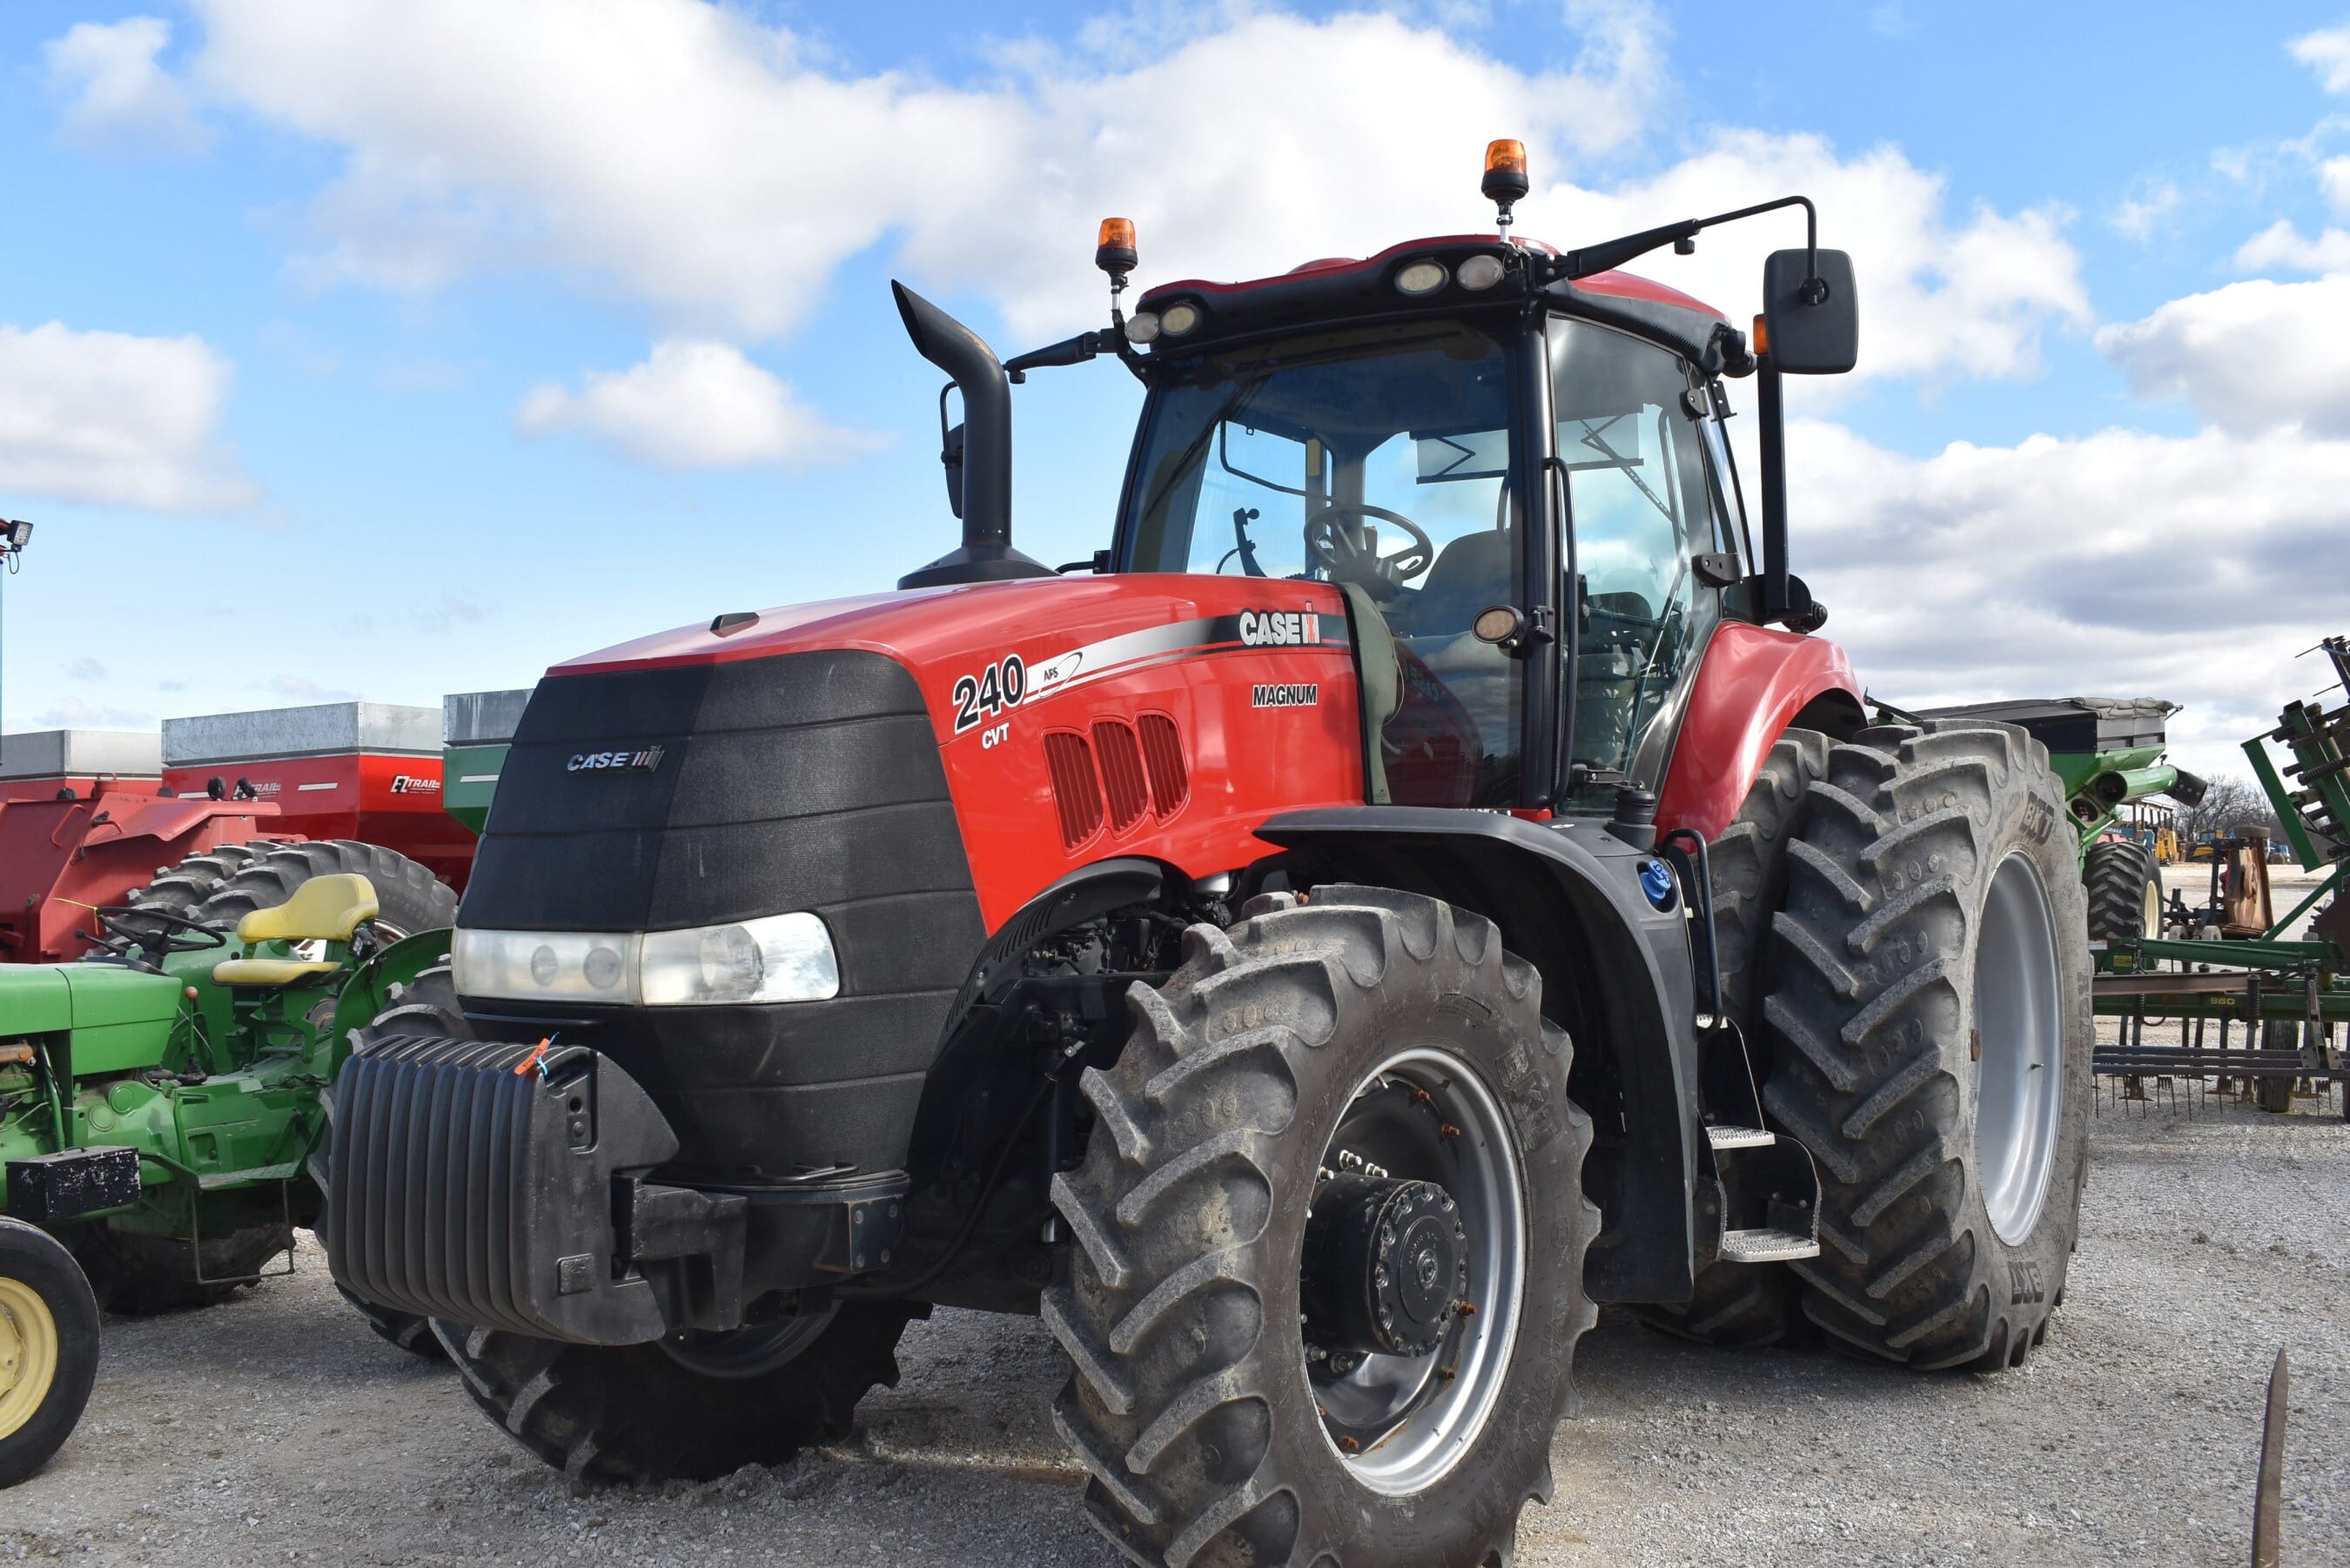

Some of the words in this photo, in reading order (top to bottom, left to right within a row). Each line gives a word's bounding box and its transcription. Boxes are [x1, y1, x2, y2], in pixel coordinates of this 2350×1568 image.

[1239, 611, 1301, 646] CASE
[953, 653, 1025, 734] 240
[1044, 667, 1058, 682] AFS
[1252, 683, 1318, 707] MAGNUM
[982, 722, 1010, 749] CVT
[567, 752, 629, 772] CASE
